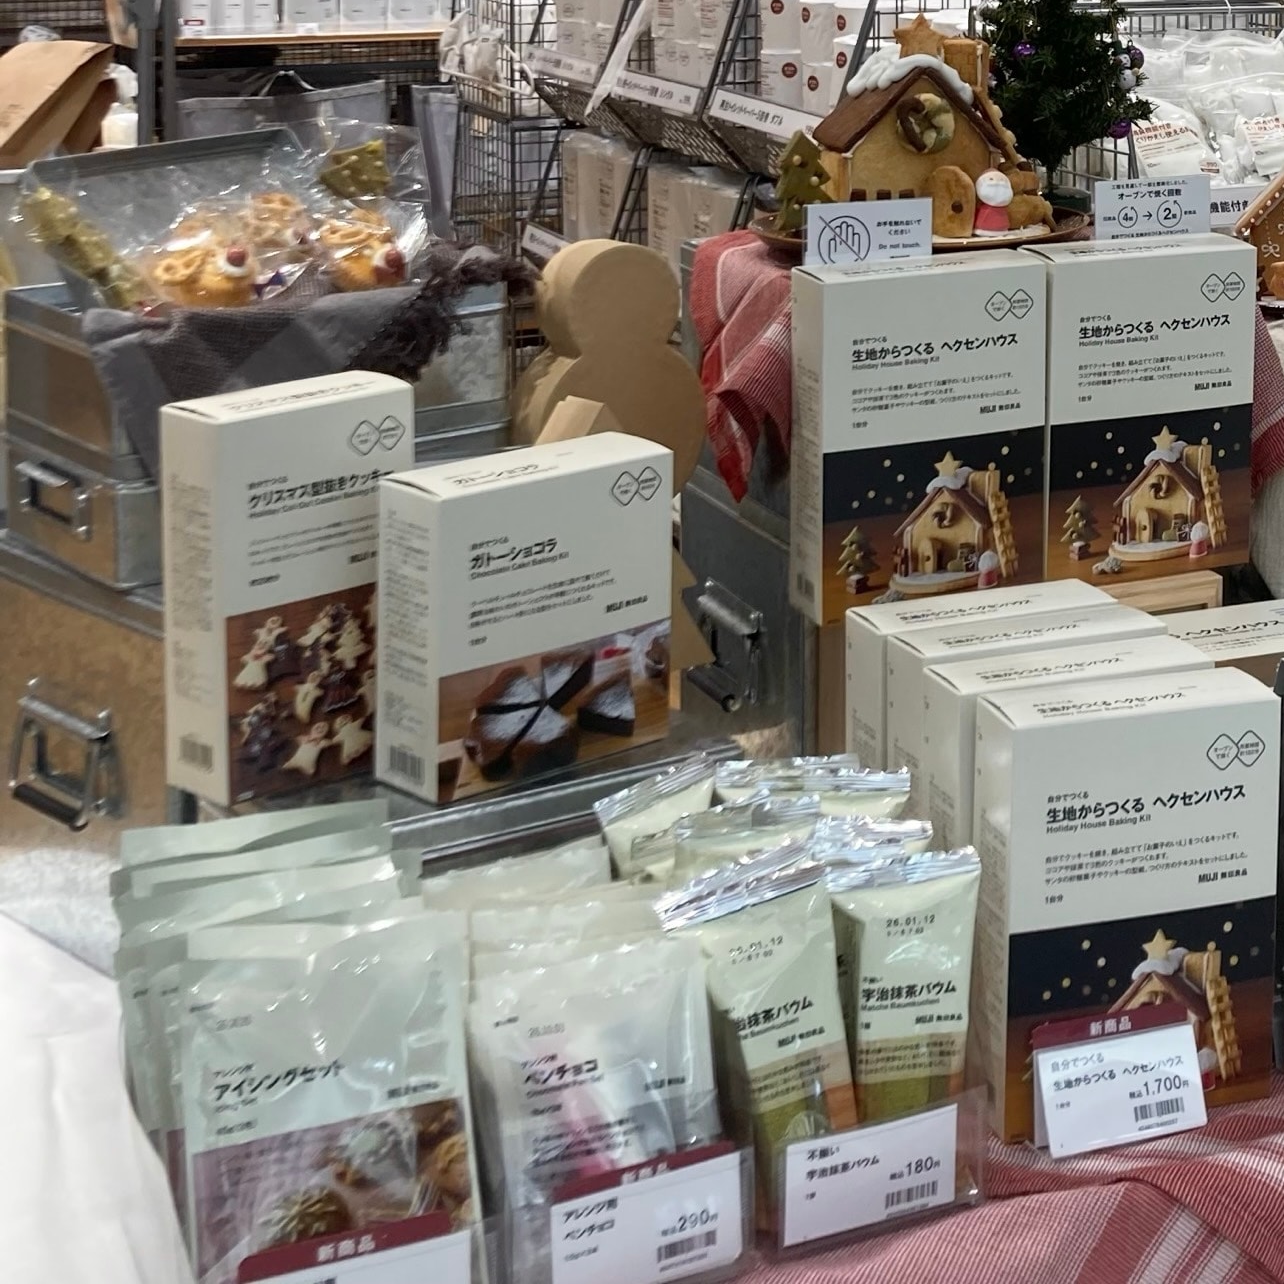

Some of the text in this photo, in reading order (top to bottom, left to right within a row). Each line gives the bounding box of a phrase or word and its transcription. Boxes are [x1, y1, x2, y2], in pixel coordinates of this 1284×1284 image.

[1079, 314, 1231, 339] 生地からつくる ヘクセンハウス
[852, 333, 1018, 363] 生地からつくる ヘクセンハウス
[470, 537, 558, 570] ガトーショコラ
[1046, 785, 1246, 825] 生地からつくる ヘクセンハウス
[1046, 822, 1079, 835] Holiday
[1108, 815, 1138, 830] Baking
[1139, 814, 1151, 823] Kit
[885, 913, 936, 929] 26.01.12
[861, 980, 956, 1004] 宇治抹茶バウム
[1090, 1016, 1132, 1037] 新商品
[523, 1059, 599, 1086] ペンチョコ
[1051, 1052, 1105, 1073] 自分でつくる
[1053, 1055, 1184, 1092] 生地からつくる ヘクセンハウス
[214, 1059, 346, 1102] アイシングセット
[806, 1155, 880, 1182] 宇治抹茶バウム
[316, 1235, 376, 1263] 新商品
